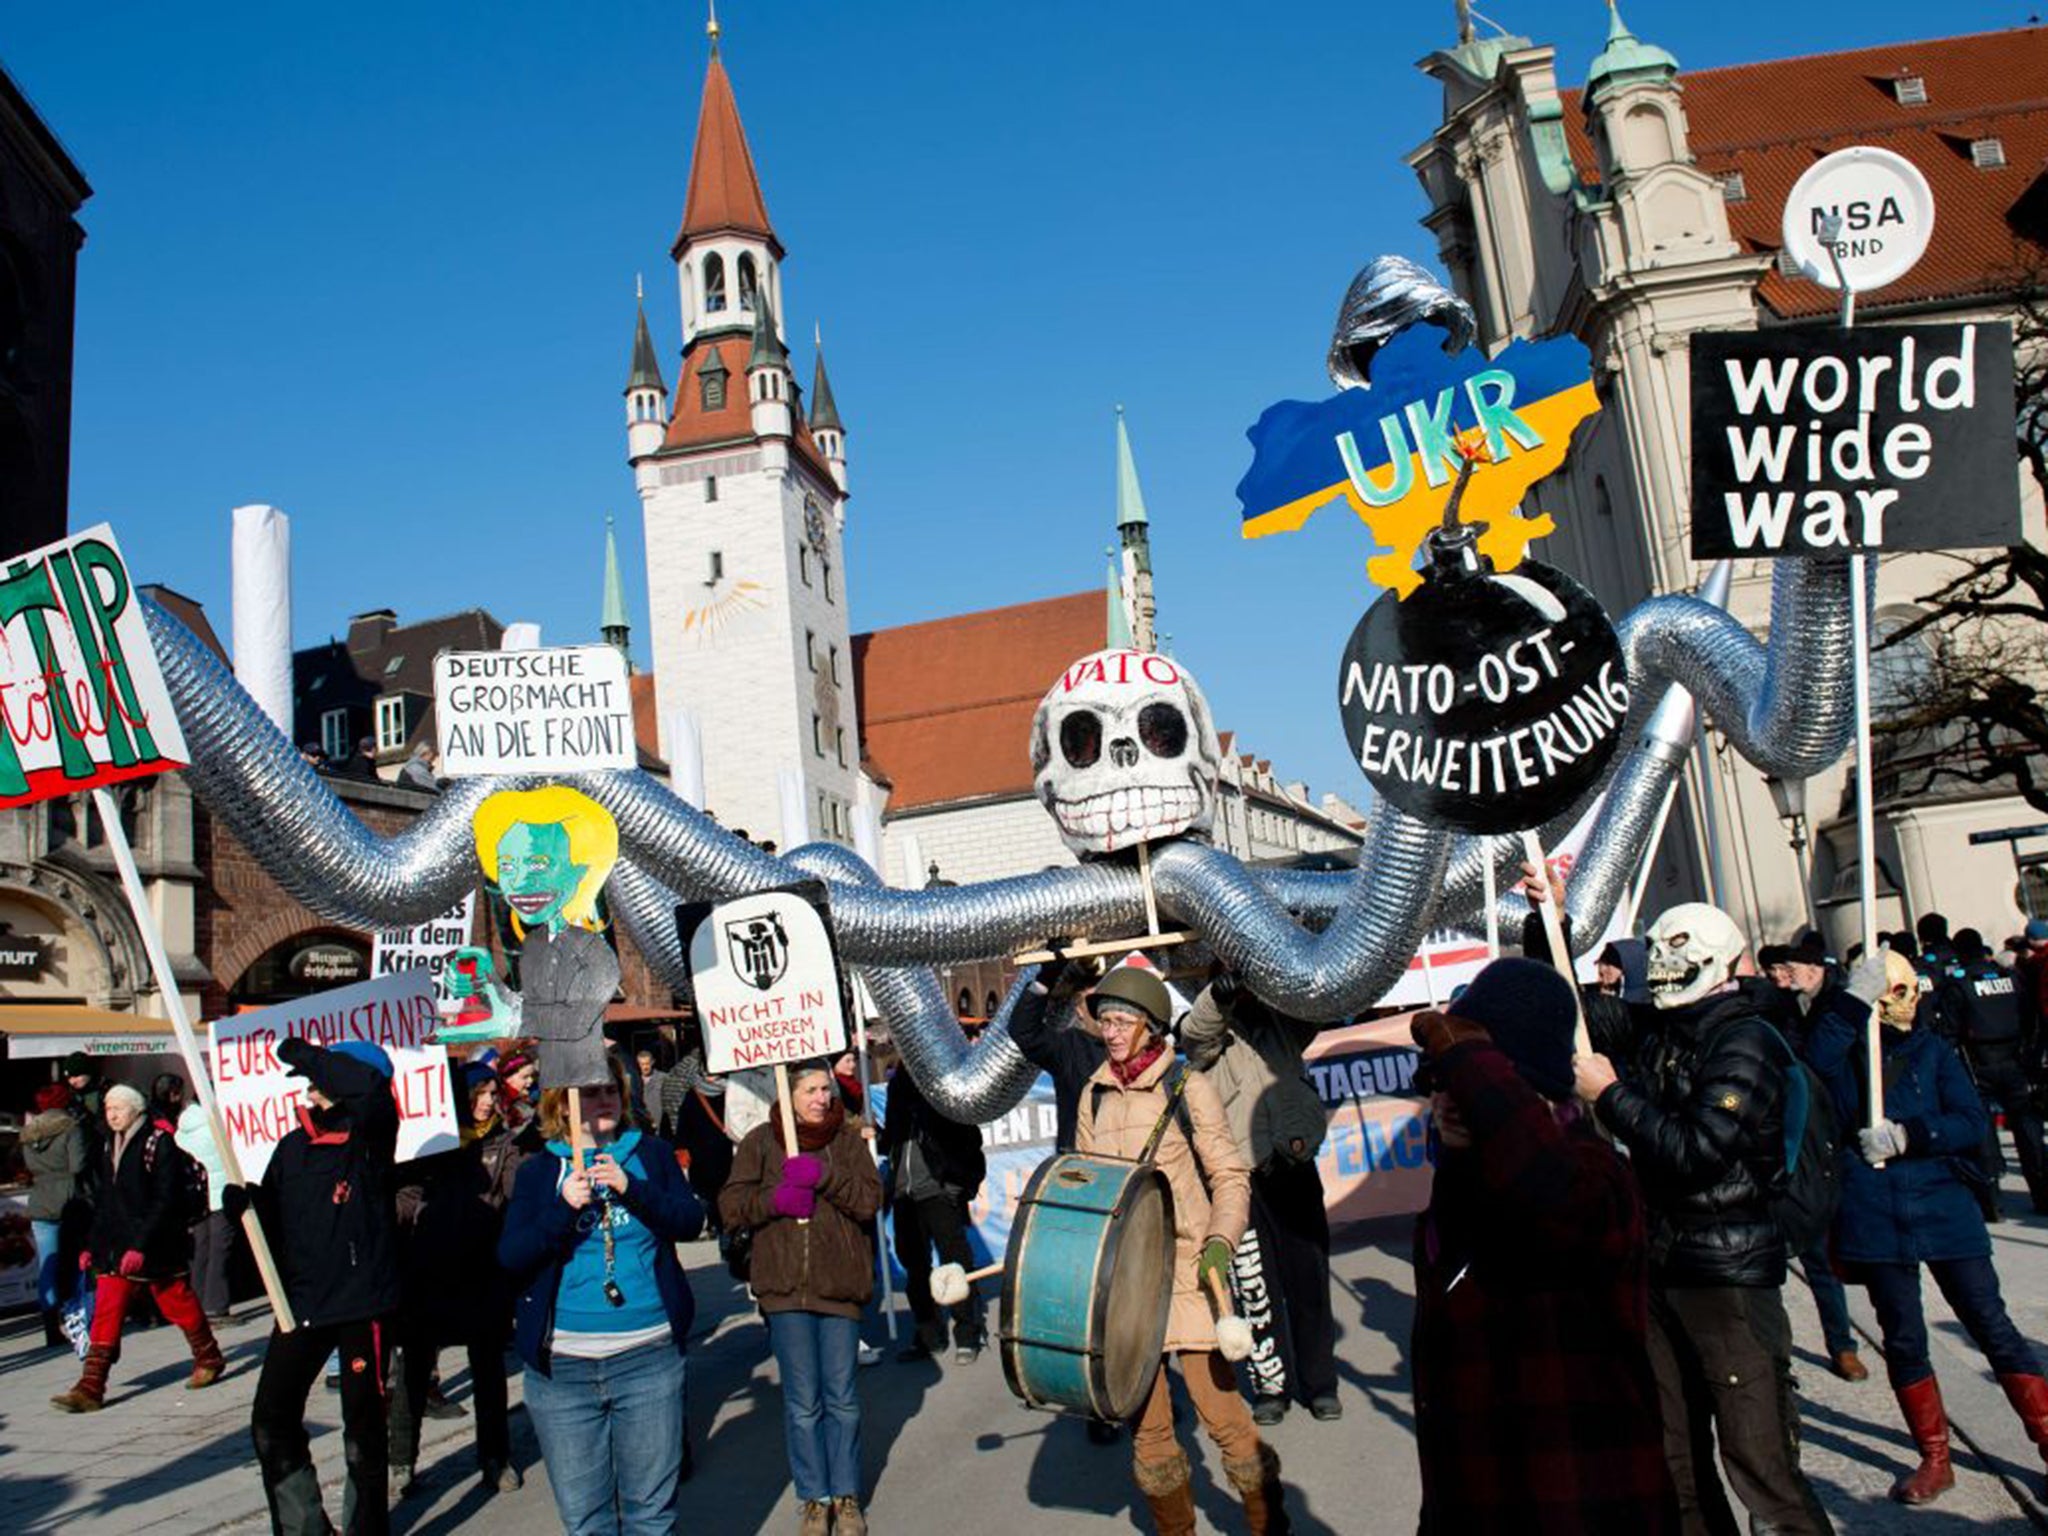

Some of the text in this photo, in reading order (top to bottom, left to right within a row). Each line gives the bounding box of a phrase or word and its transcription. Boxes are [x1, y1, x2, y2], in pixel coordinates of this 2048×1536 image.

[1811, 196, 1904, 235] NSA
[1836, 238, 1883, 258] BND
[1724, 324, 1976, 415] world
[1335, 369, 1545, 507] UKR
[1725, 411, 1932, 483] wide
[1724, 488, 1899, 549] war
[448, 654, 584, 678] DEUTSCHE
[449, 681, 613, 715] GROßMACHT
[447, 713, 628, 758] AN DIE FRONT
[1361, 661, 1630, 795] ERWEITERUNG
[420, 923, 464, 945] dem
[1974, 977, 2014, 997] POLIZEI
[709, 990, 824, 1028] NICHT IN
[84, 1040, 167, 1052] vinzenzmurr
[737, 1016, 815, 1043] UNSEREM
[217, 1028, 281, 1082] EUER
[225, 1089, 302, 1147] MACHT
